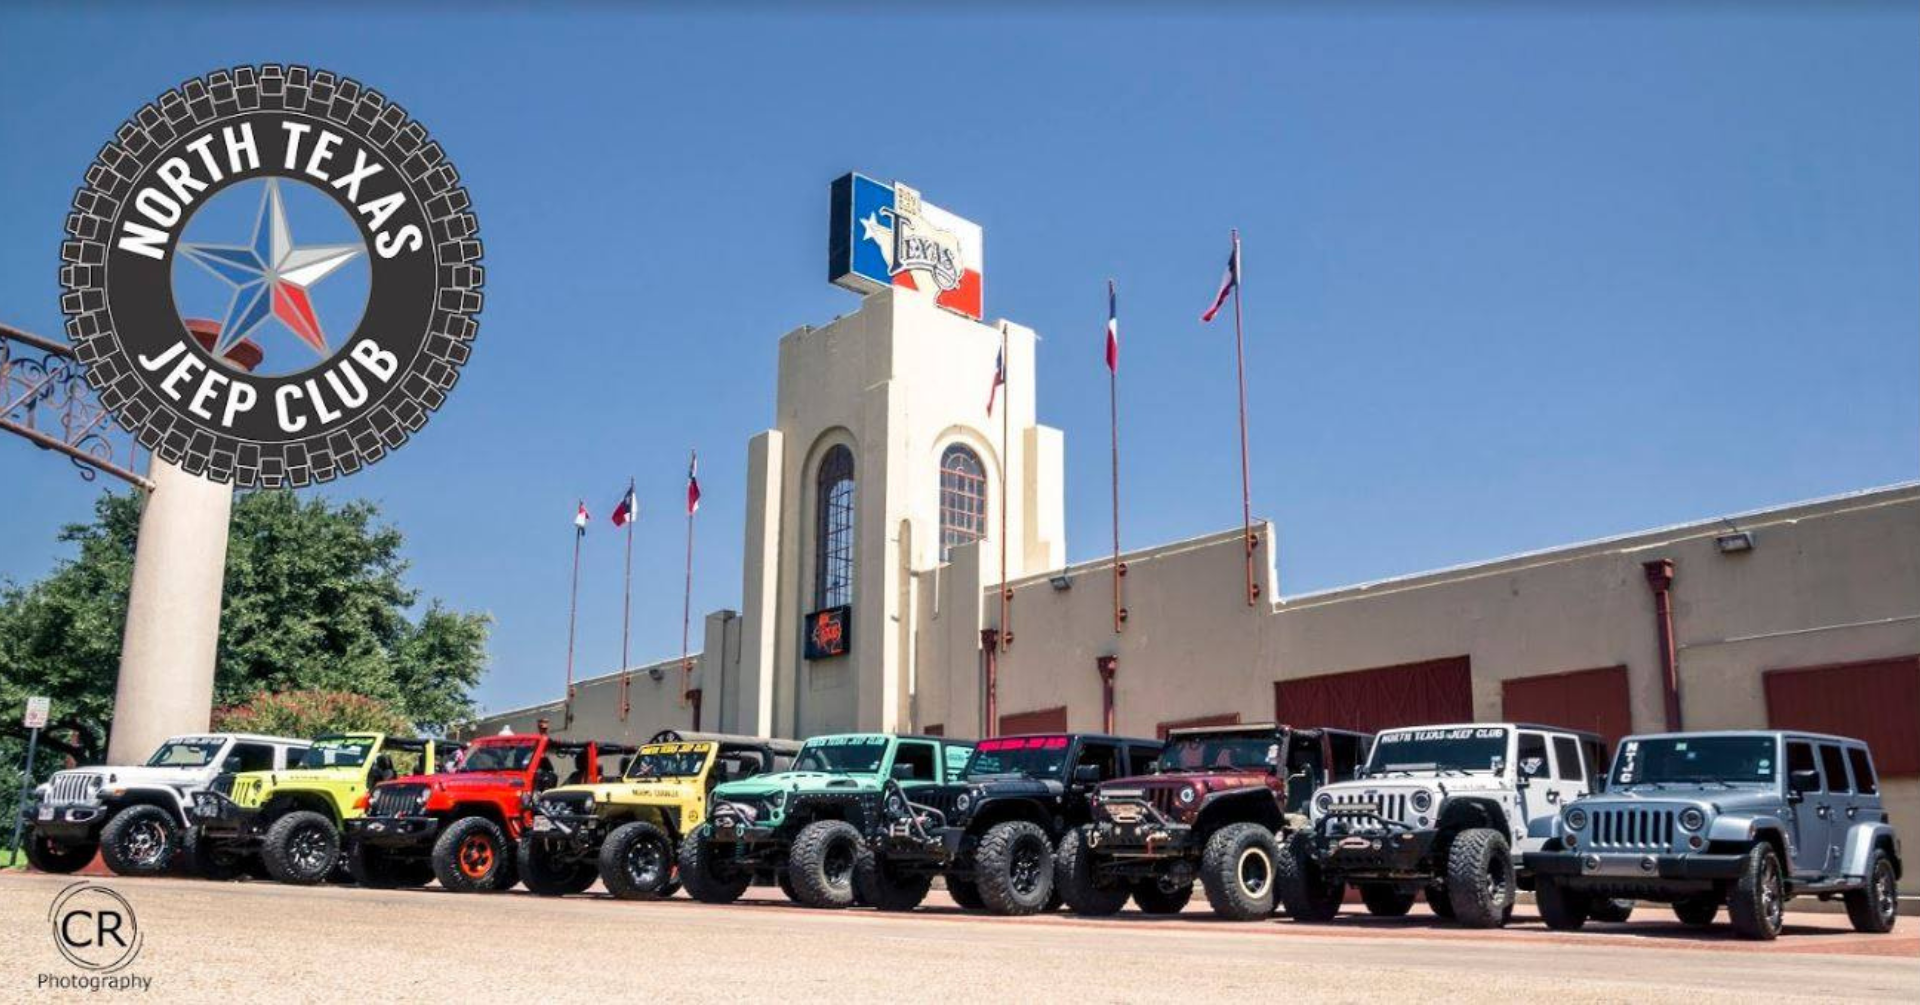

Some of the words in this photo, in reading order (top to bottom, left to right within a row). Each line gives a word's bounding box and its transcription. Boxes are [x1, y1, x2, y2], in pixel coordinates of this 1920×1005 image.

[1381, 733, 1412, 743] NORTH
[1415, 730, 1446, 740] TEXAS
[1448, 729, 1473, 739] JEEP
[1476, 728, 1503, 738] CLUB
